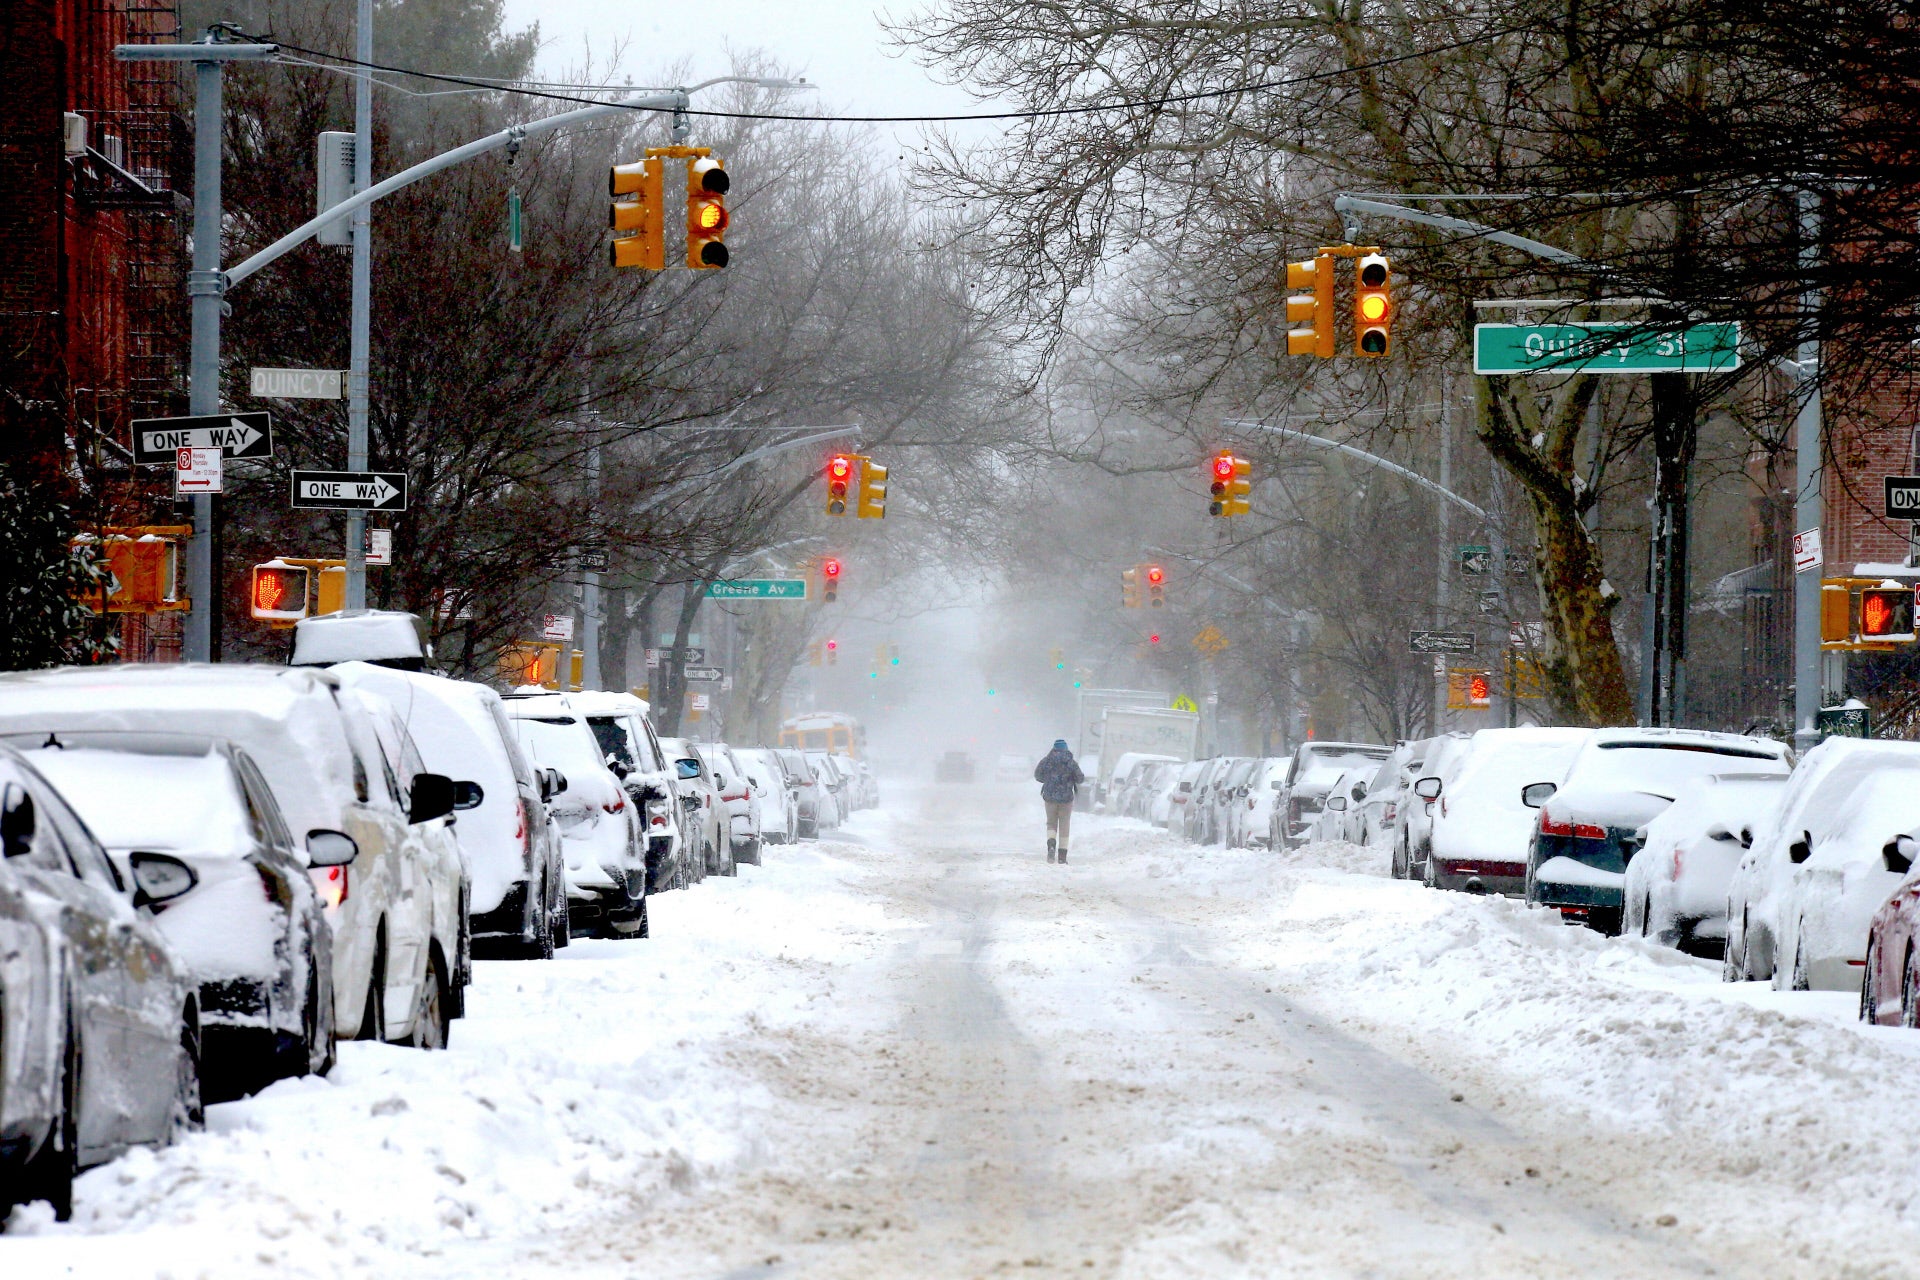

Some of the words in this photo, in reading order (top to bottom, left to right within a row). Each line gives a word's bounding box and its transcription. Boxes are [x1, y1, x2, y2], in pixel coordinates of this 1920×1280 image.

[1656, 332, 1688, 357] St
[254, 373, 326, 395] QUINCY
[153, 431, 192, 450] ONE
[209, 428, 249, 447] WAY
[309, 483, 341, 497] ONE
[356, 484, 389, 499] WAY
[713, 583, 759, 595] Greene
[768, 584, 785, 595] Av
